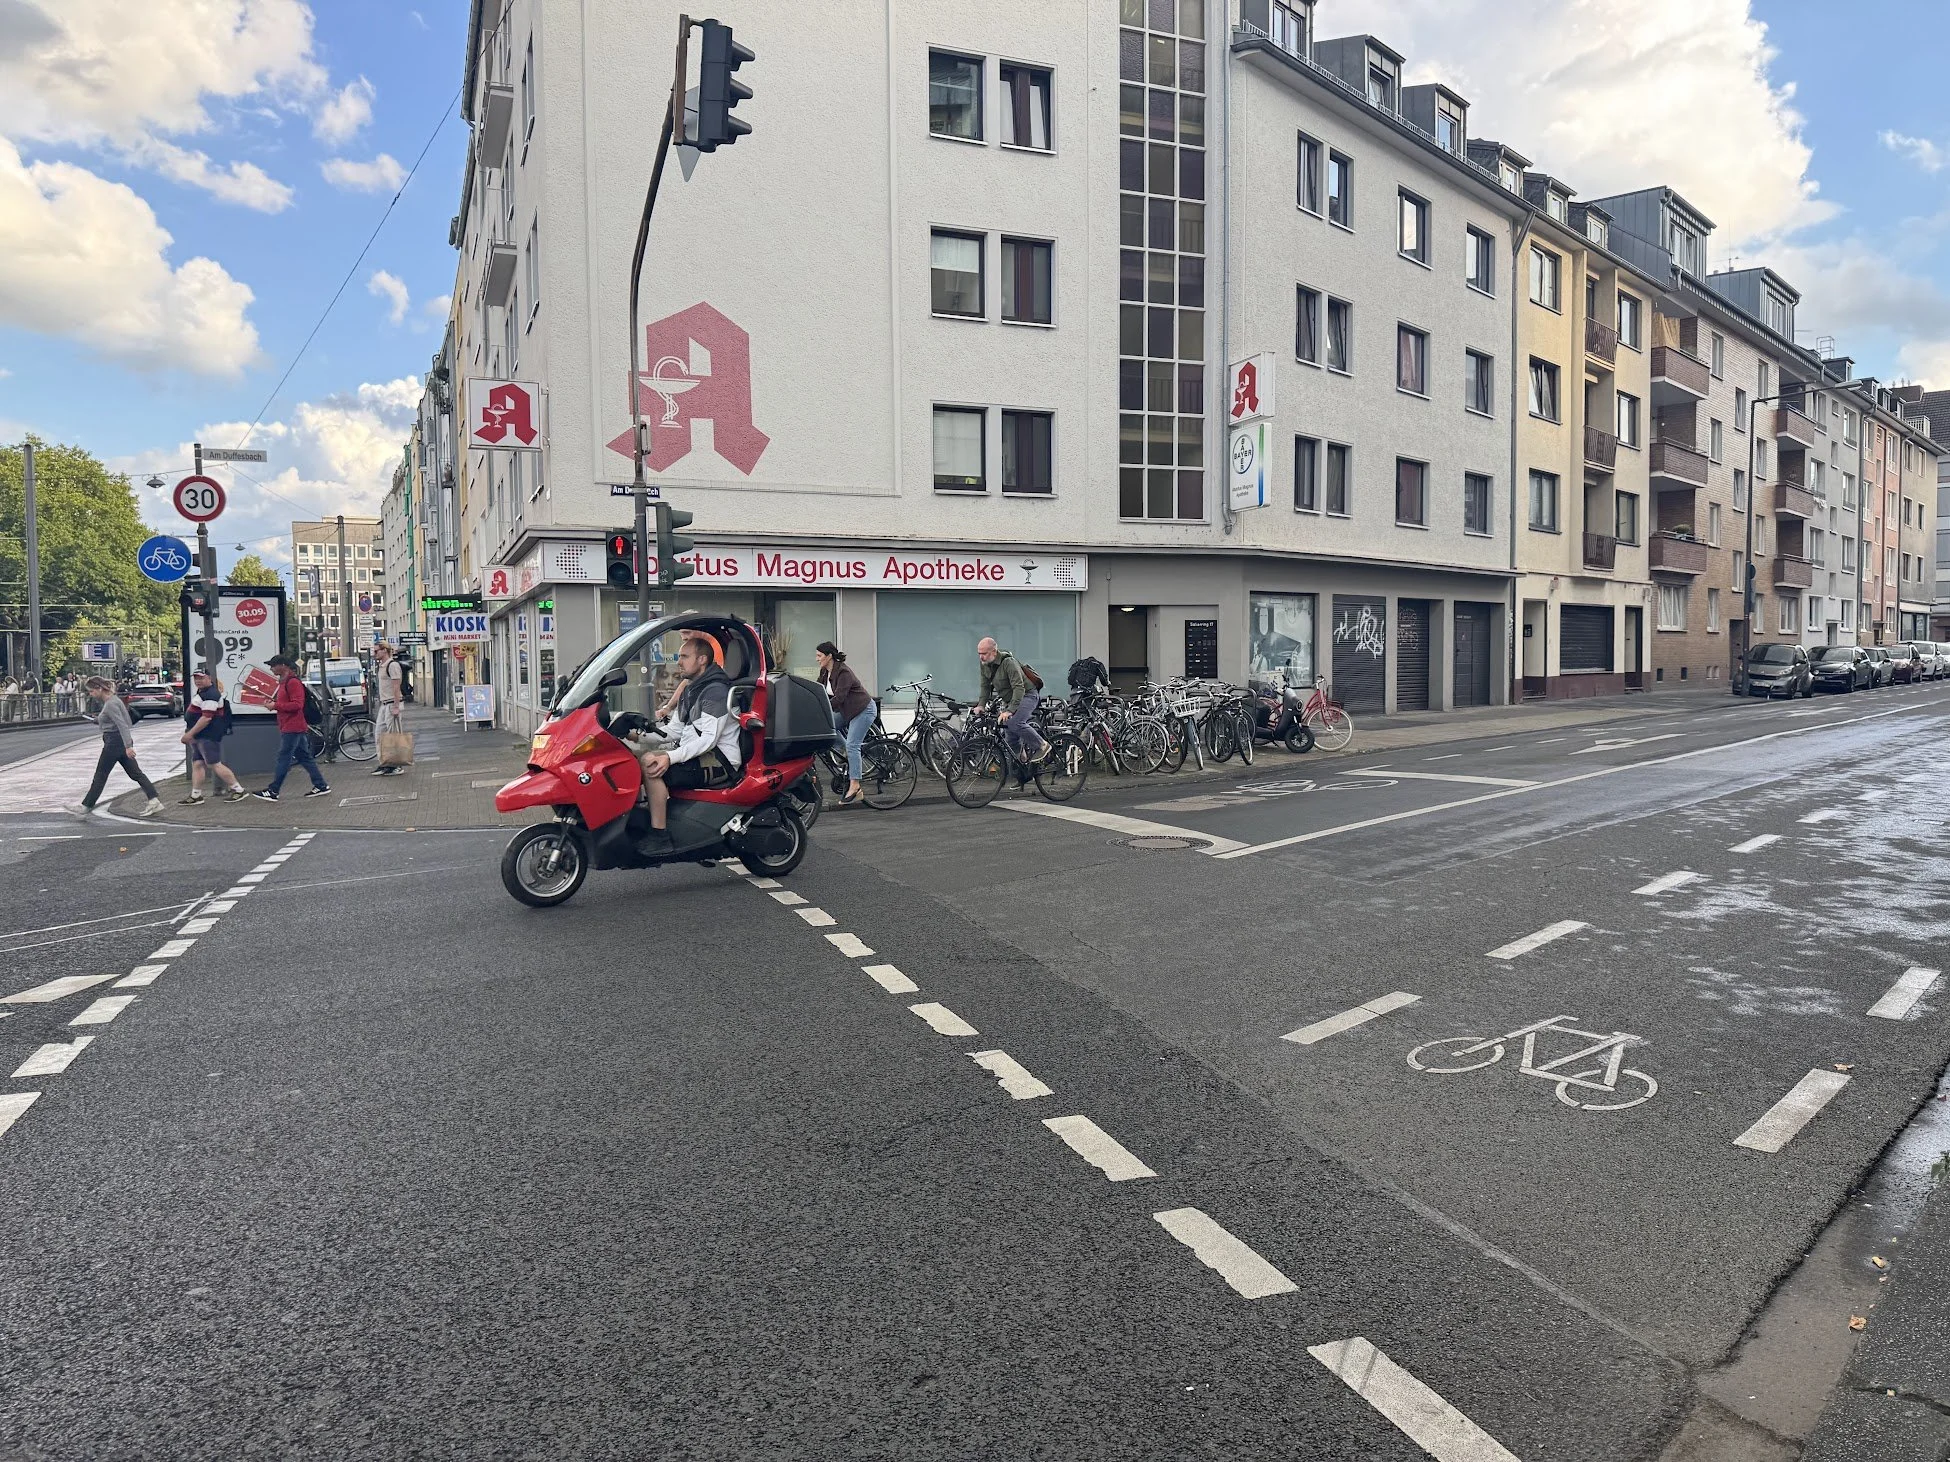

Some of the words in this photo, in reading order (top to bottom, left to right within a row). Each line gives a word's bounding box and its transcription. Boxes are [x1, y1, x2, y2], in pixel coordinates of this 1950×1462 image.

[209, 451, 221, 459] Am
[223, 451, 262, 461] Duffesbach
[1234, 449, 1252, 460] BAYER
[613, 486, 623, 494] Am
[185, 488, 214, 509] 30
[757, 553, 867, 584] Magnus
[883, 556, 1005, 585] Apotheke
[237, 607, 267, 618] 30.09.
[436, 616, 486, 633] KIOSK
[458, 633, 481, 641] MARKET
[224, 636, 253, 652] 99
